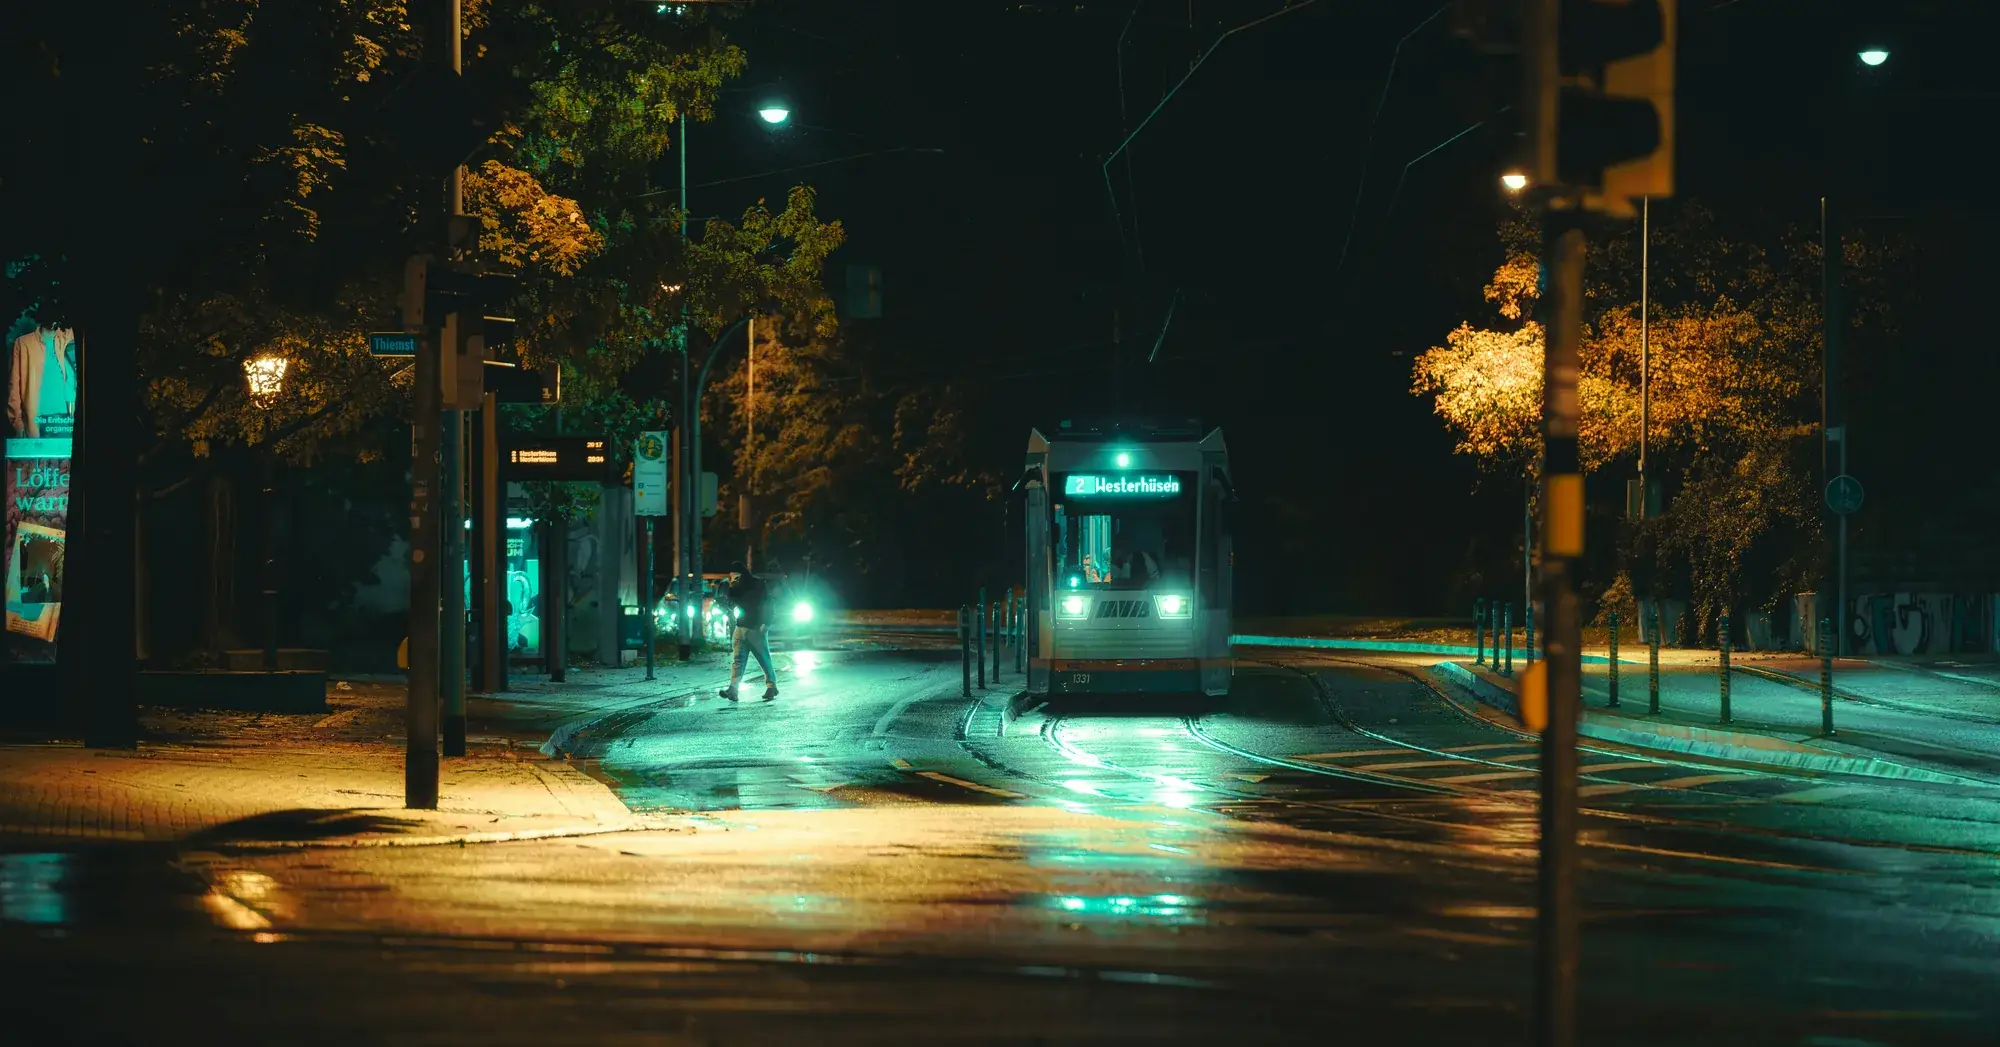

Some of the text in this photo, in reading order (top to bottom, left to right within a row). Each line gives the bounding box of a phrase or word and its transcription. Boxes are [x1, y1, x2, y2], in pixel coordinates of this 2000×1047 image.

[1075, 477, 1180, 493] 2 Westerhüsen
[1073, 673, 1091, 684] 1331
